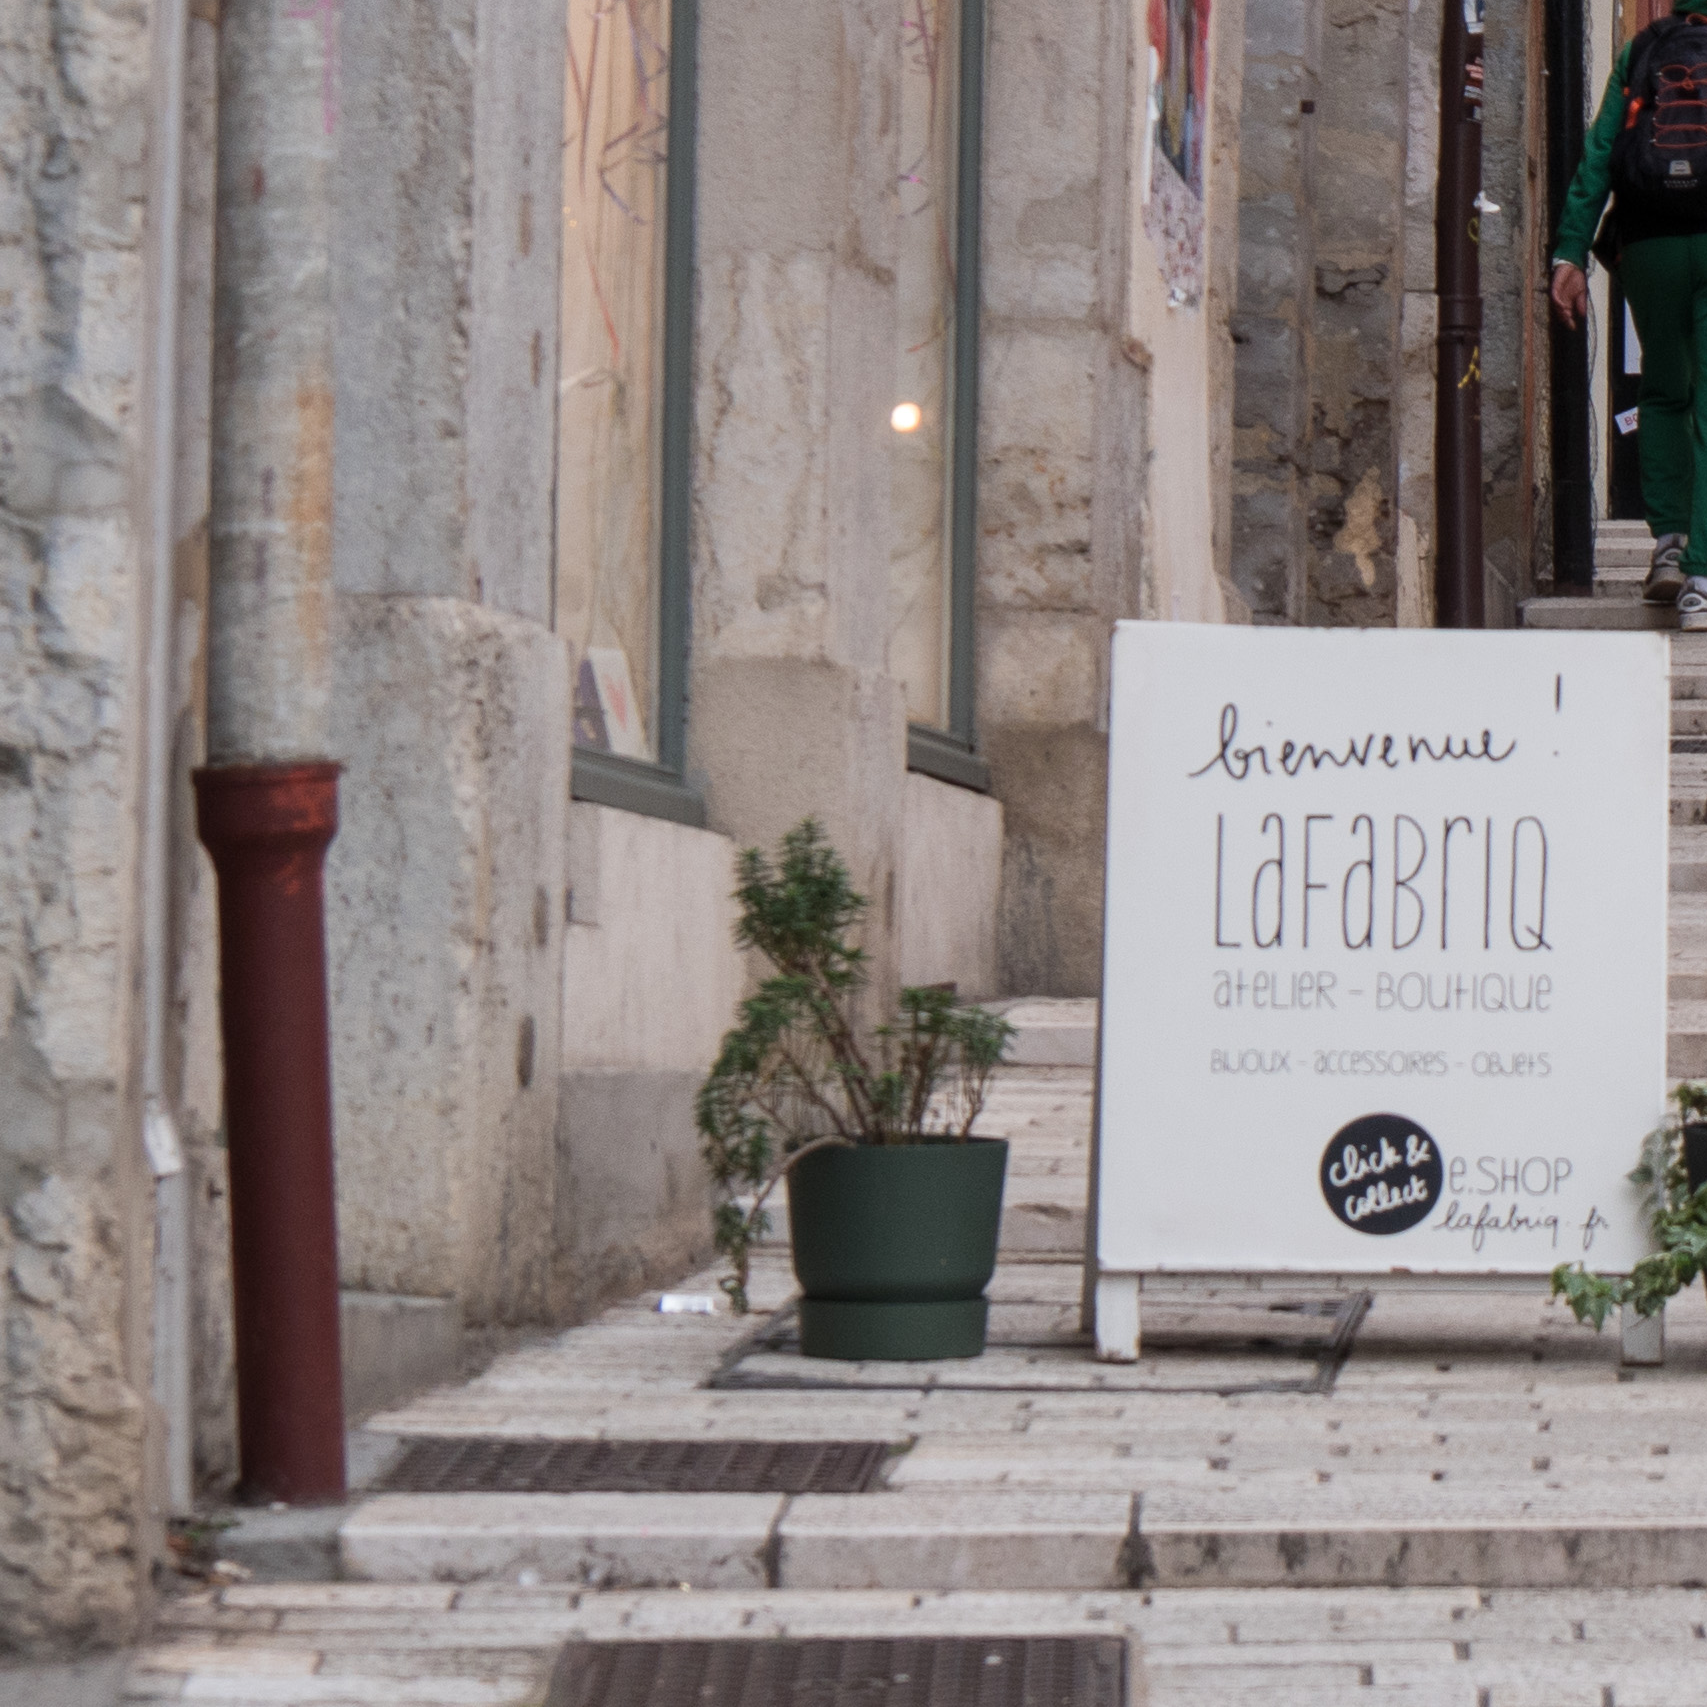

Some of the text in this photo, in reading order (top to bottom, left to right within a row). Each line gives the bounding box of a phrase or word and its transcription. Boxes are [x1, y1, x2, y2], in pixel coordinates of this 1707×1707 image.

[1188, 701, 1518, 784] bienvenue
[1328, 1134, 1433, 1188] click &
[1448, 1154, 1574, 1197] e.SHOP
[1343, 1174, 1430, 1222] collect
